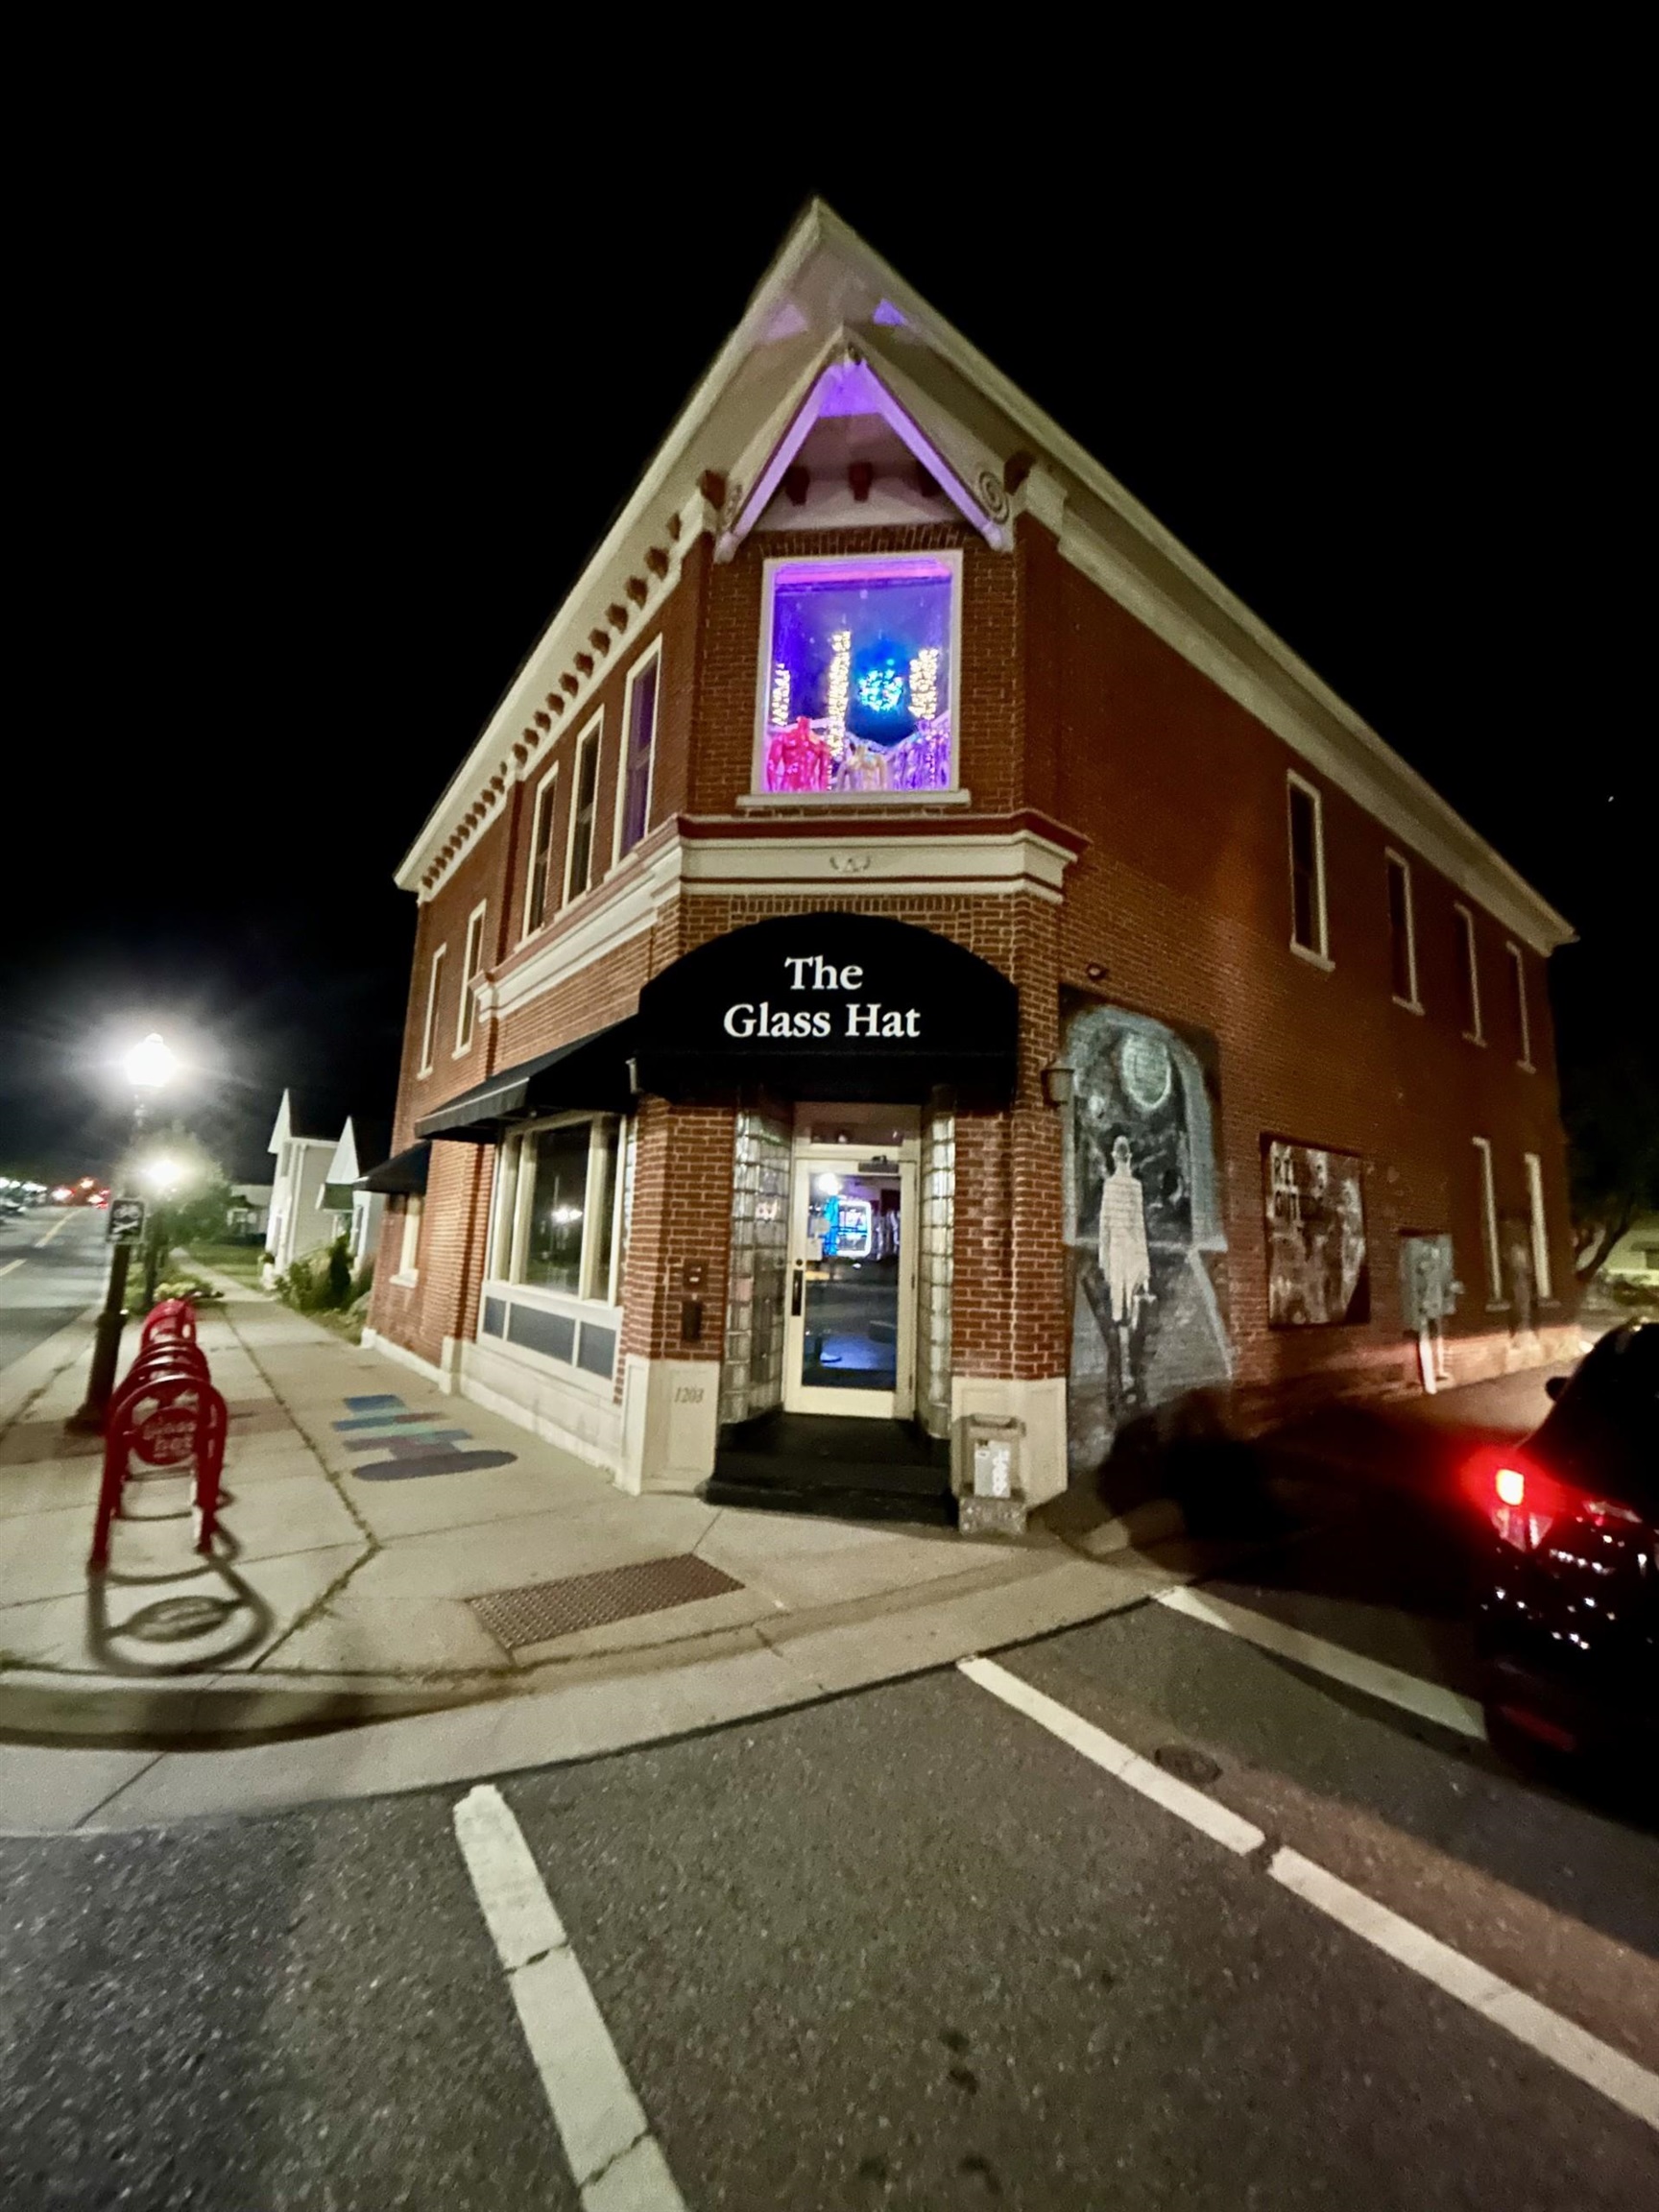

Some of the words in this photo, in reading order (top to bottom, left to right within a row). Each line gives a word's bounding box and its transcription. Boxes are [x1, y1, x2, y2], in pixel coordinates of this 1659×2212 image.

[784, 955, 863, 990] The
[723, 1002, 831, 1038] Glass
[845, 1003, 921, 1038] Hat
